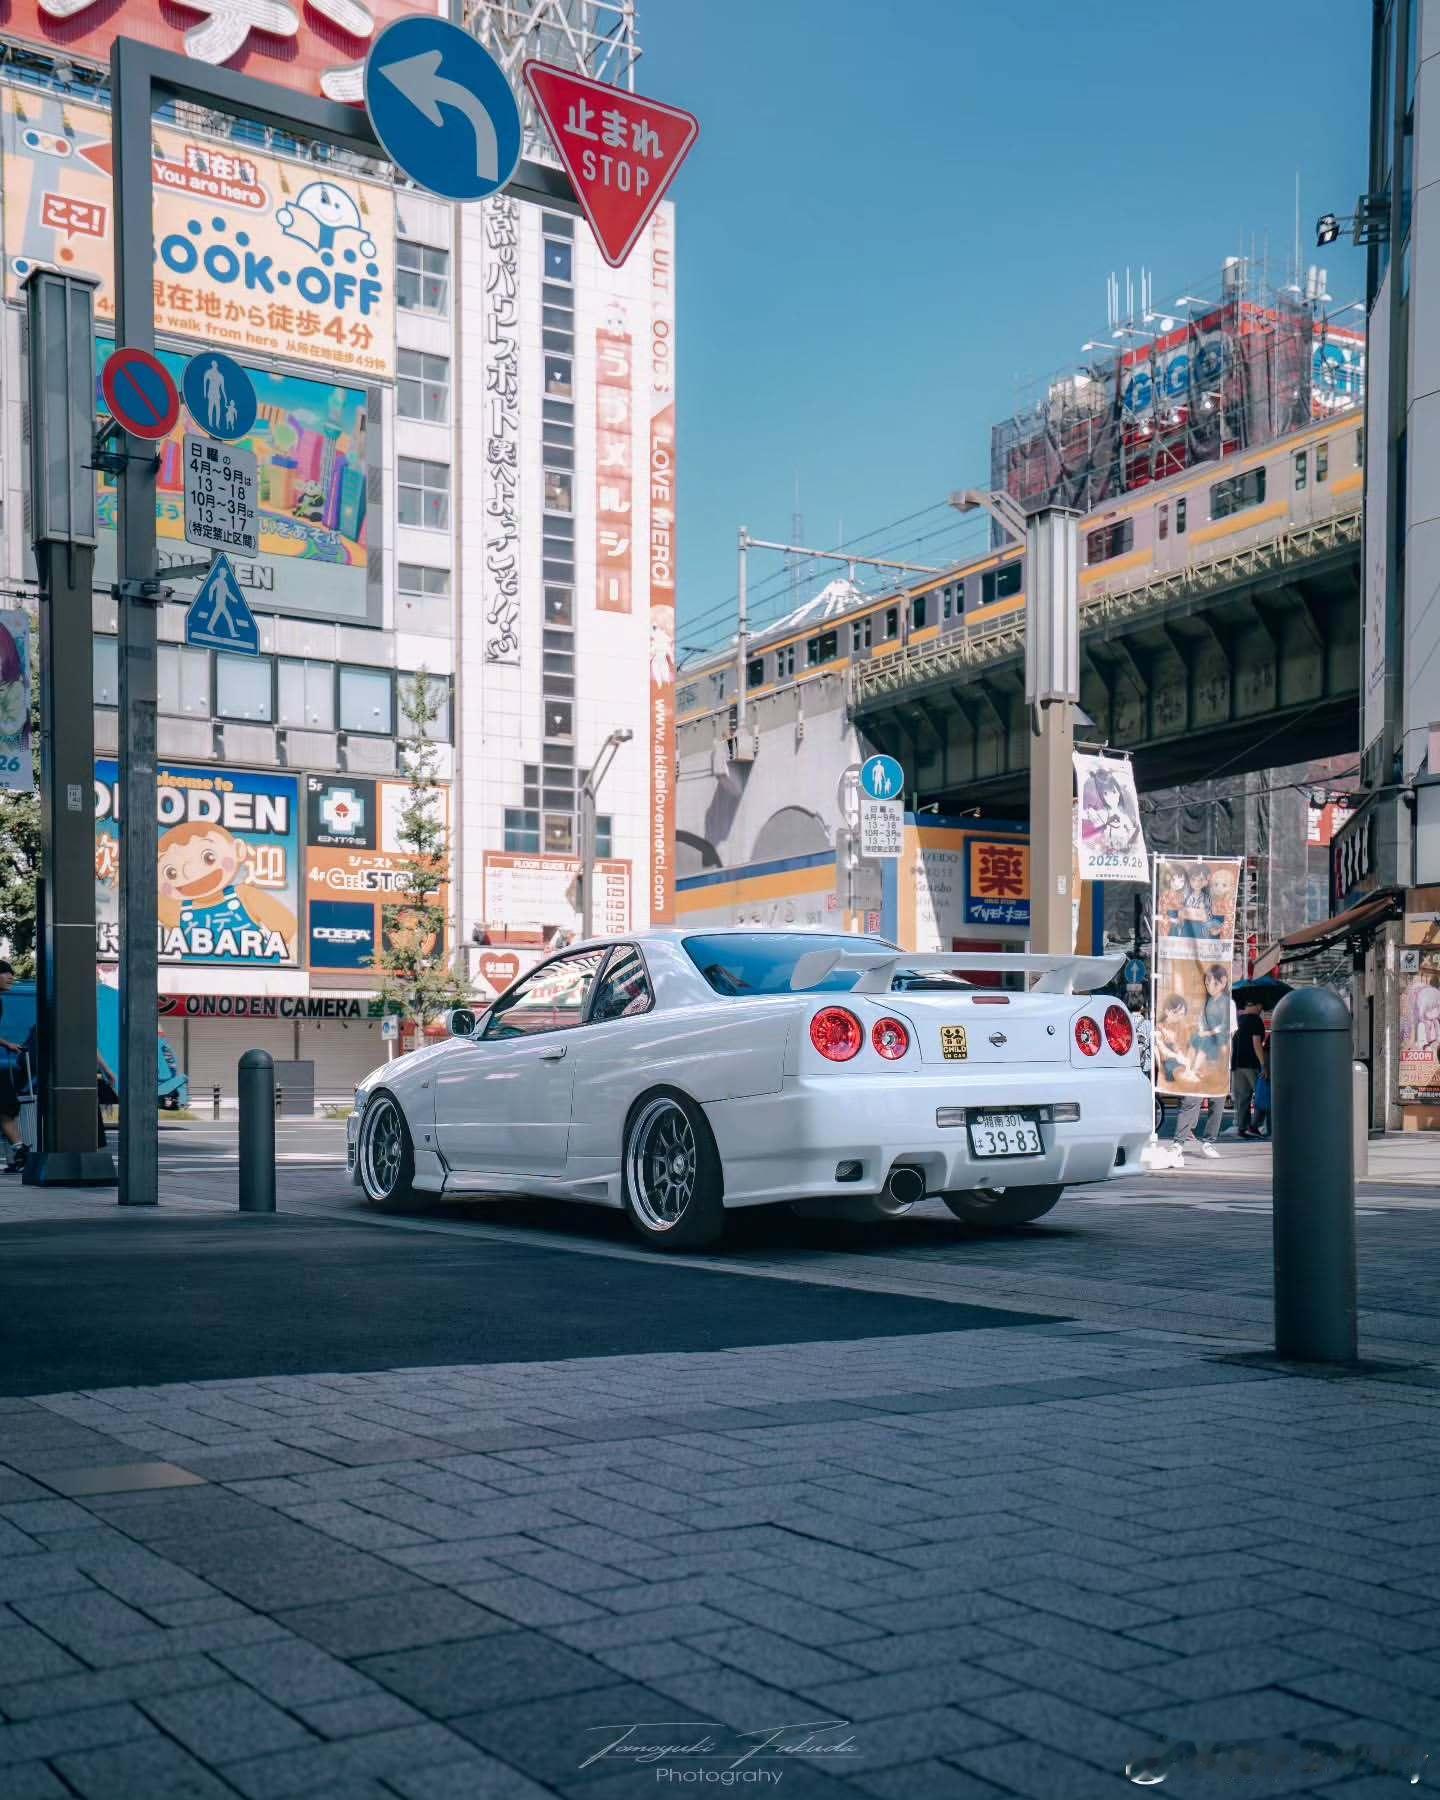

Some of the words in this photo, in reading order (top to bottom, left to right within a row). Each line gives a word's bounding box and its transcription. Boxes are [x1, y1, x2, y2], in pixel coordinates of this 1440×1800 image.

[564, 97, 664, 160] 止まれ
[154, 162, 187, 186] You
[189, 175, 219, 194] are
[221, 180, 261, 204] here
[582, 150, 650, 197] STOP
[47, 200, 102, 231] ここ!
[168, 313, 200, 331] walk
[207, 322, 241, 342] from
[246, 330, 280, 348] here
[192, 442, 231, 466] 日曜の
[652, 435, 672, 501] LOVE
[652, 507, 674, 589] MERCI
[308, 779, 323, 791] 5F
[653, 698, 667, 911] www.akibalovemerci.com
[309, 867, 326, 881] 4F
[978, 846, 1023, 896] 薬
[1088, 855, 1143, 869] 2025.9.26
[186, 996, 277, 1018] ONODEN
[279, 998, 362, 1018] CAMERA
[943, 1045, 967, 1054] CHILD
[985, 1129, 1039, 1154] 39-83
